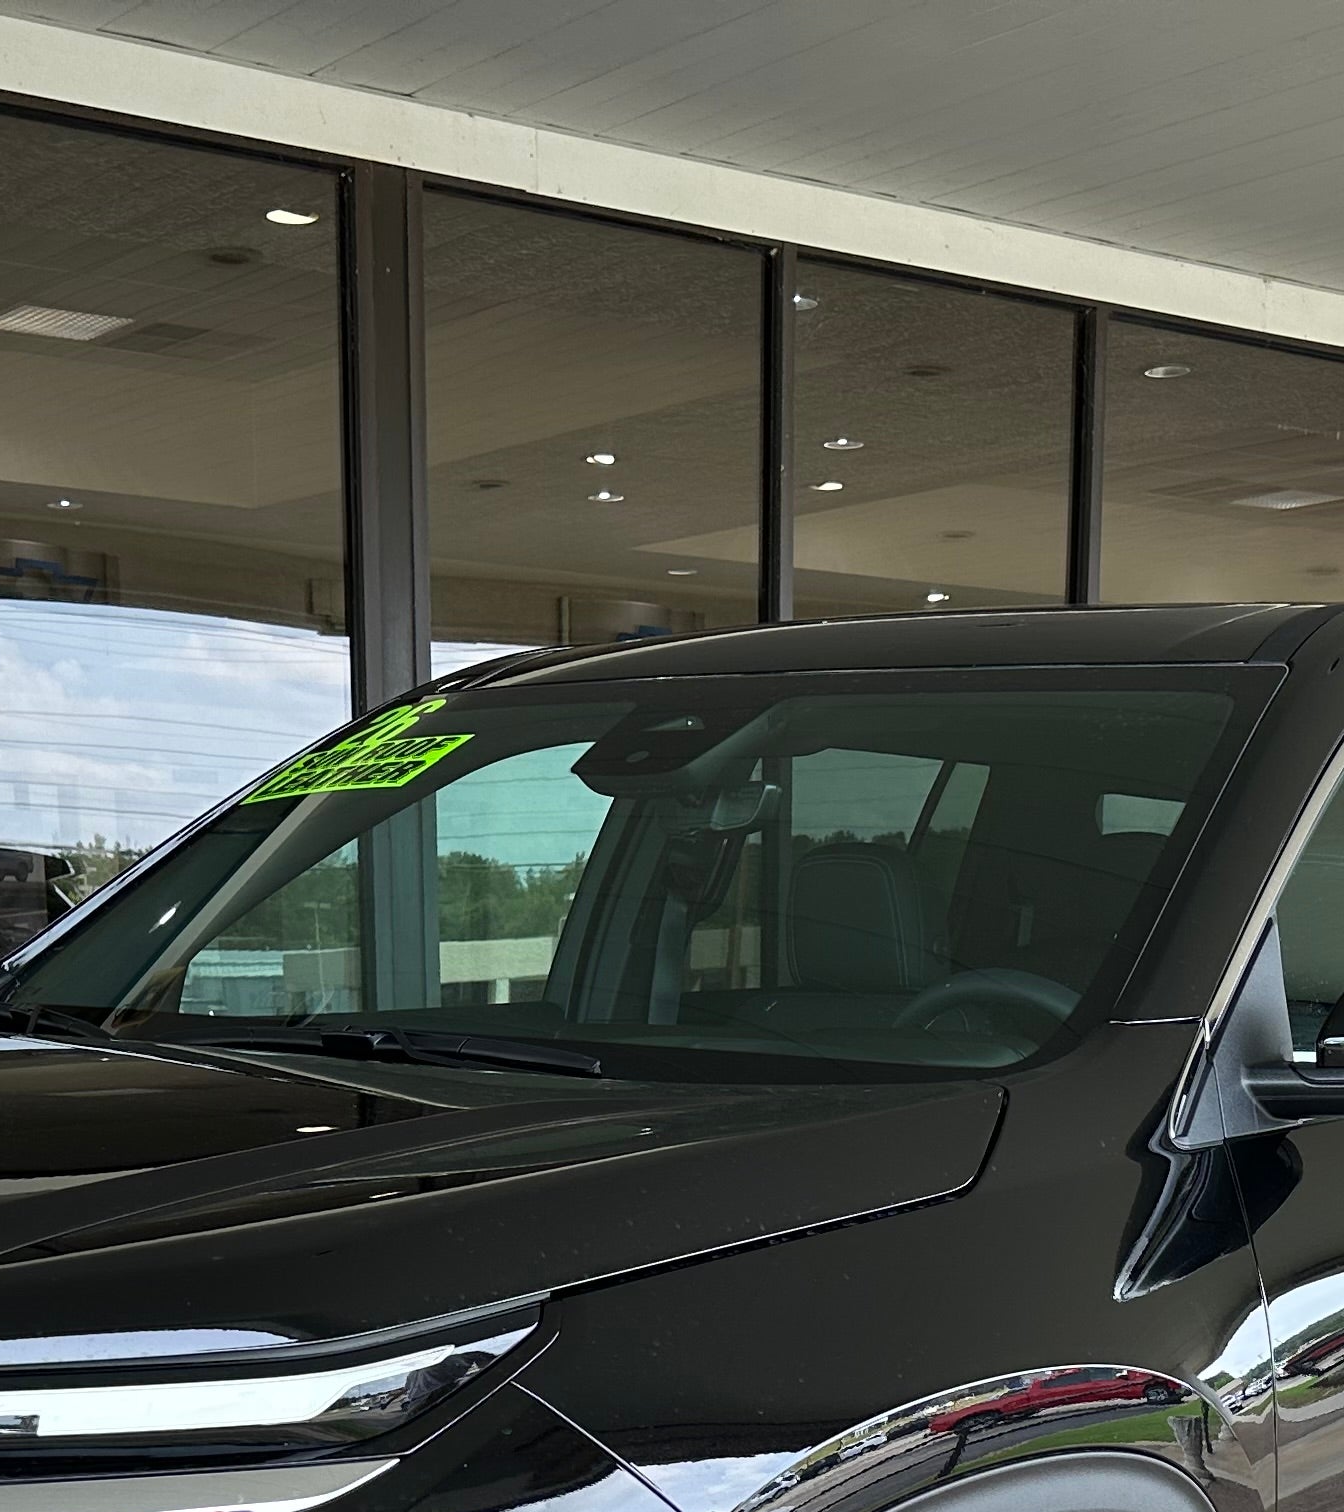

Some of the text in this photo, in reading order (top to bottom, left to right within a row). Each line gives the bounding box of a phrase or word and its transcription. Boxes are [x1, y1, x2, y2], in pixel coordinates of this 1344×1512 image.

[335, 699, 447, 749] 26
[289, 736, 462, 777] SUN ROOF
[248, 759, 428, 800] LEATHER
